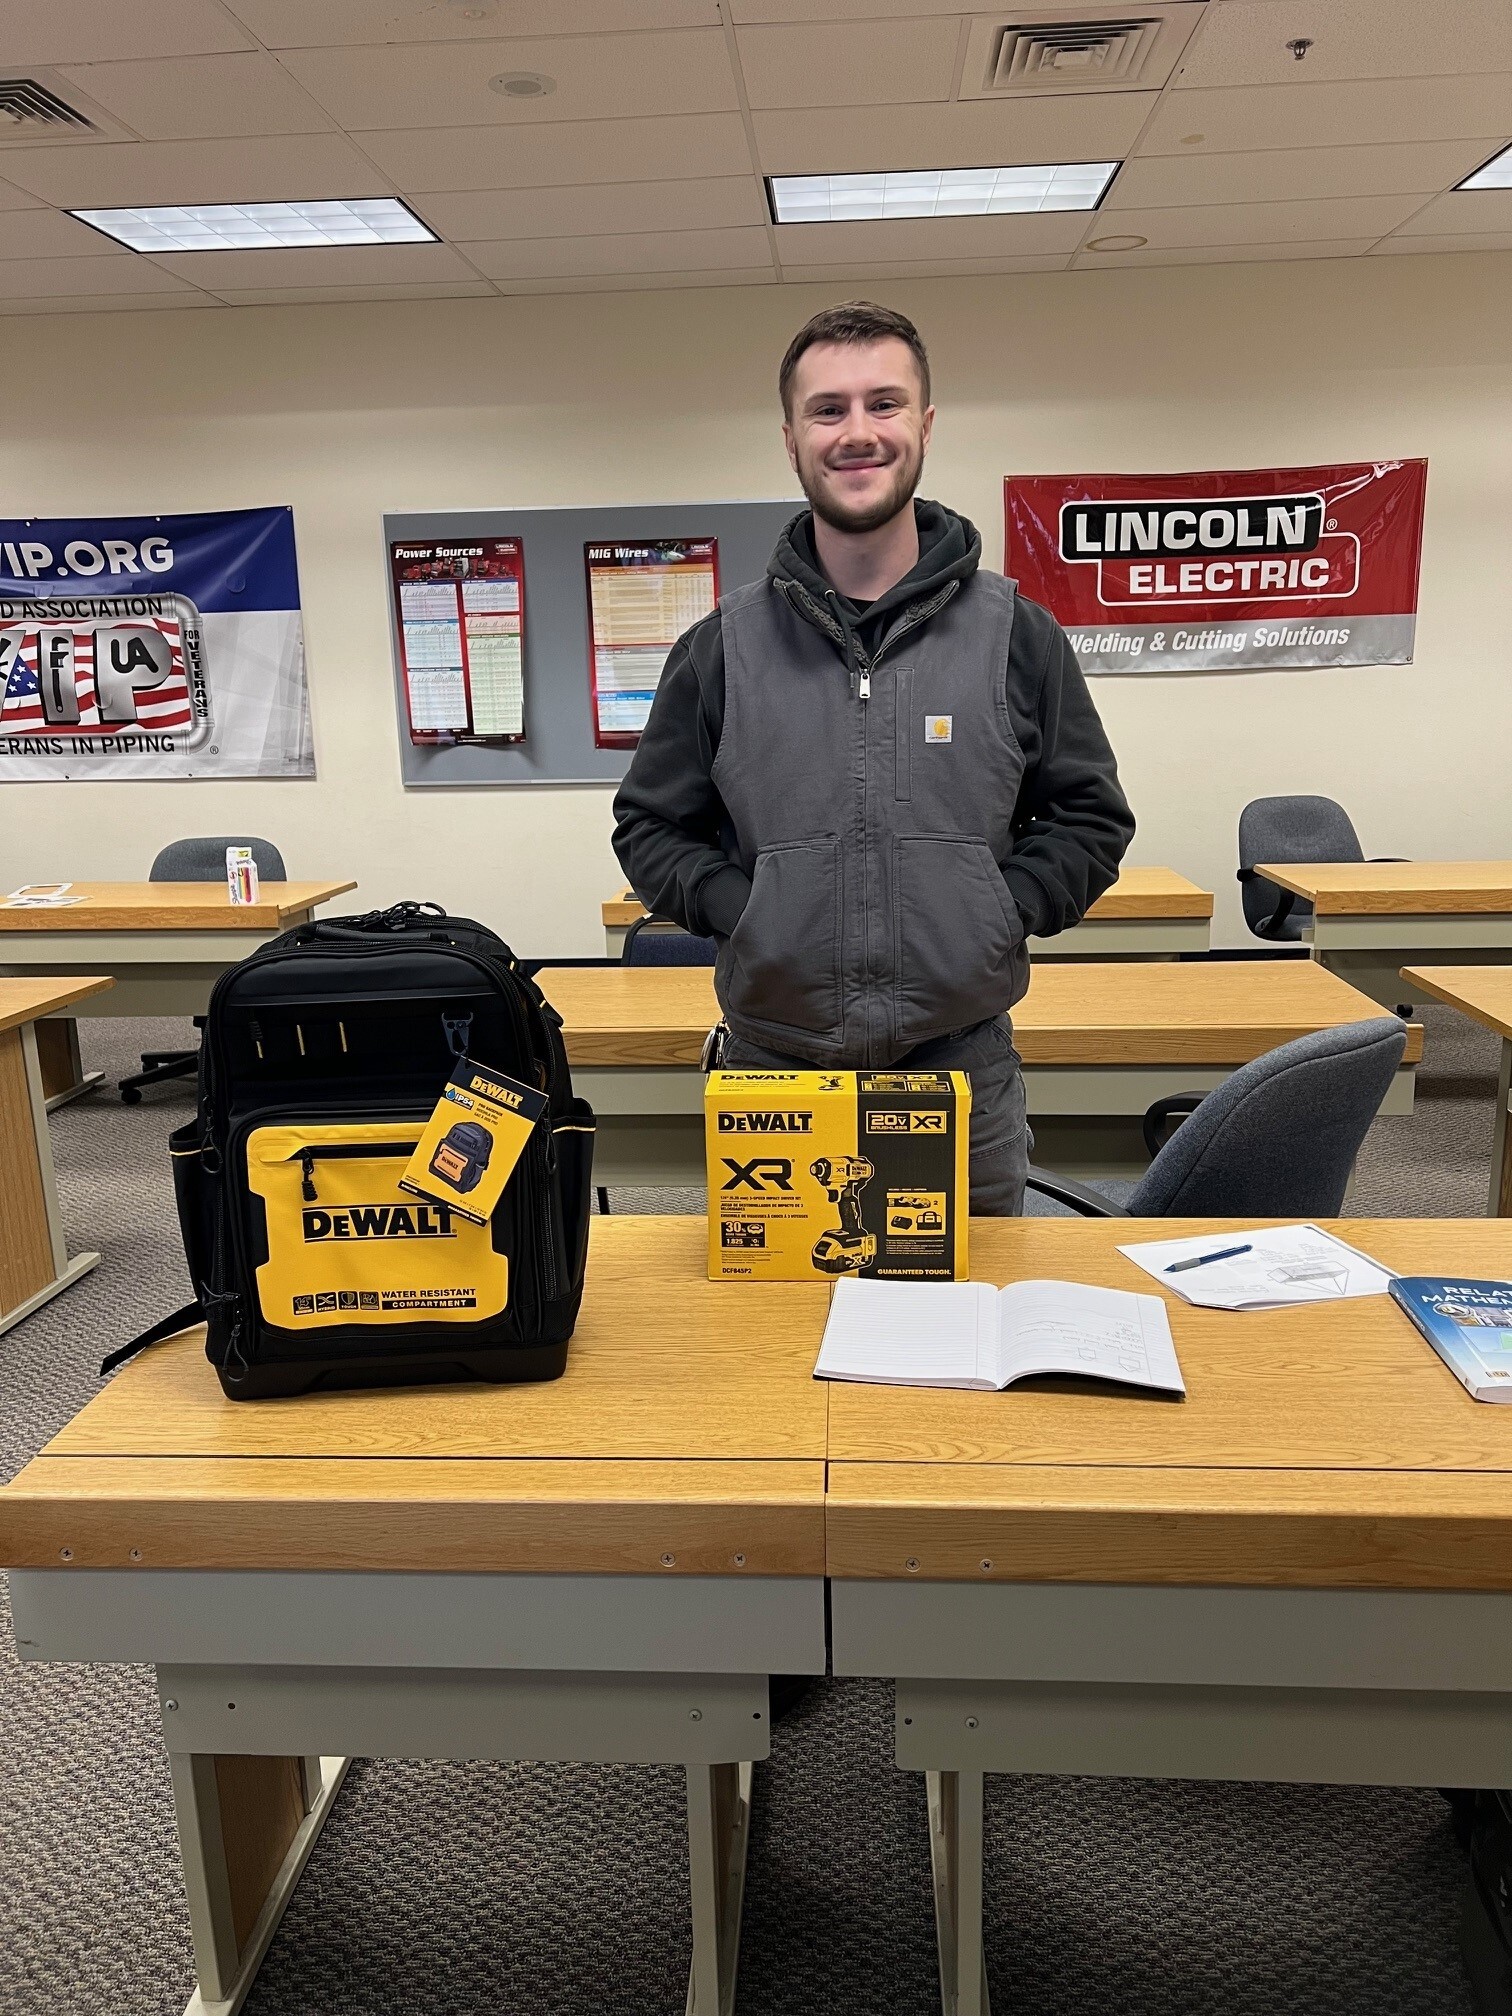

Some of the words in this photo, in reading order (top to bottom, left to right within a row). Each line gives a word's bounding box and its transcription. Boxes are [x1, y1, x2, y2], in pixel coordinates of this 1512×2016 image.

[1076, 505, 1306, 552] LINCOLN
[0, 538, 174, 577] IP.ORG
[395, 548, 432, 559] Power
[435, 547, 484, 558] Sources
[588, 548, 612, 559] MIG
[614, 547, 649, 558] Wires
[1129, 558, 1330, 594] ELECTRIC
[22, 597, 163, 619] ASSOCIATION
[184, 630, 200, 640] FOR
[1067, 633, 1145, 656] Welding
[1149, 632, 1166, 651] &
[1172, 630, 1247, 652] Cutting
[1252, 626, 1350, 648] Solutions
[187, 641, 208, 718] VETERANS
[71, 736, 95, 754] IN
[102, 734, 175, 755] PIPING
[455, 1092, 475, 1107] IP54
[470, 1075, 524, 1109] DEWALT
[718, 1112, 813, 1132] DEWALT
[912, 1115, 943, 1129] XR
[720, 1157, 795, 1190] XR
[302, 1207, 454, 1240] DEWALT
[381, 1290, 416, 1299] WATER
[420, 1288, 476, 1298] RESISTANT
[392, 1299, 467, 1308] COMPARTMENT
